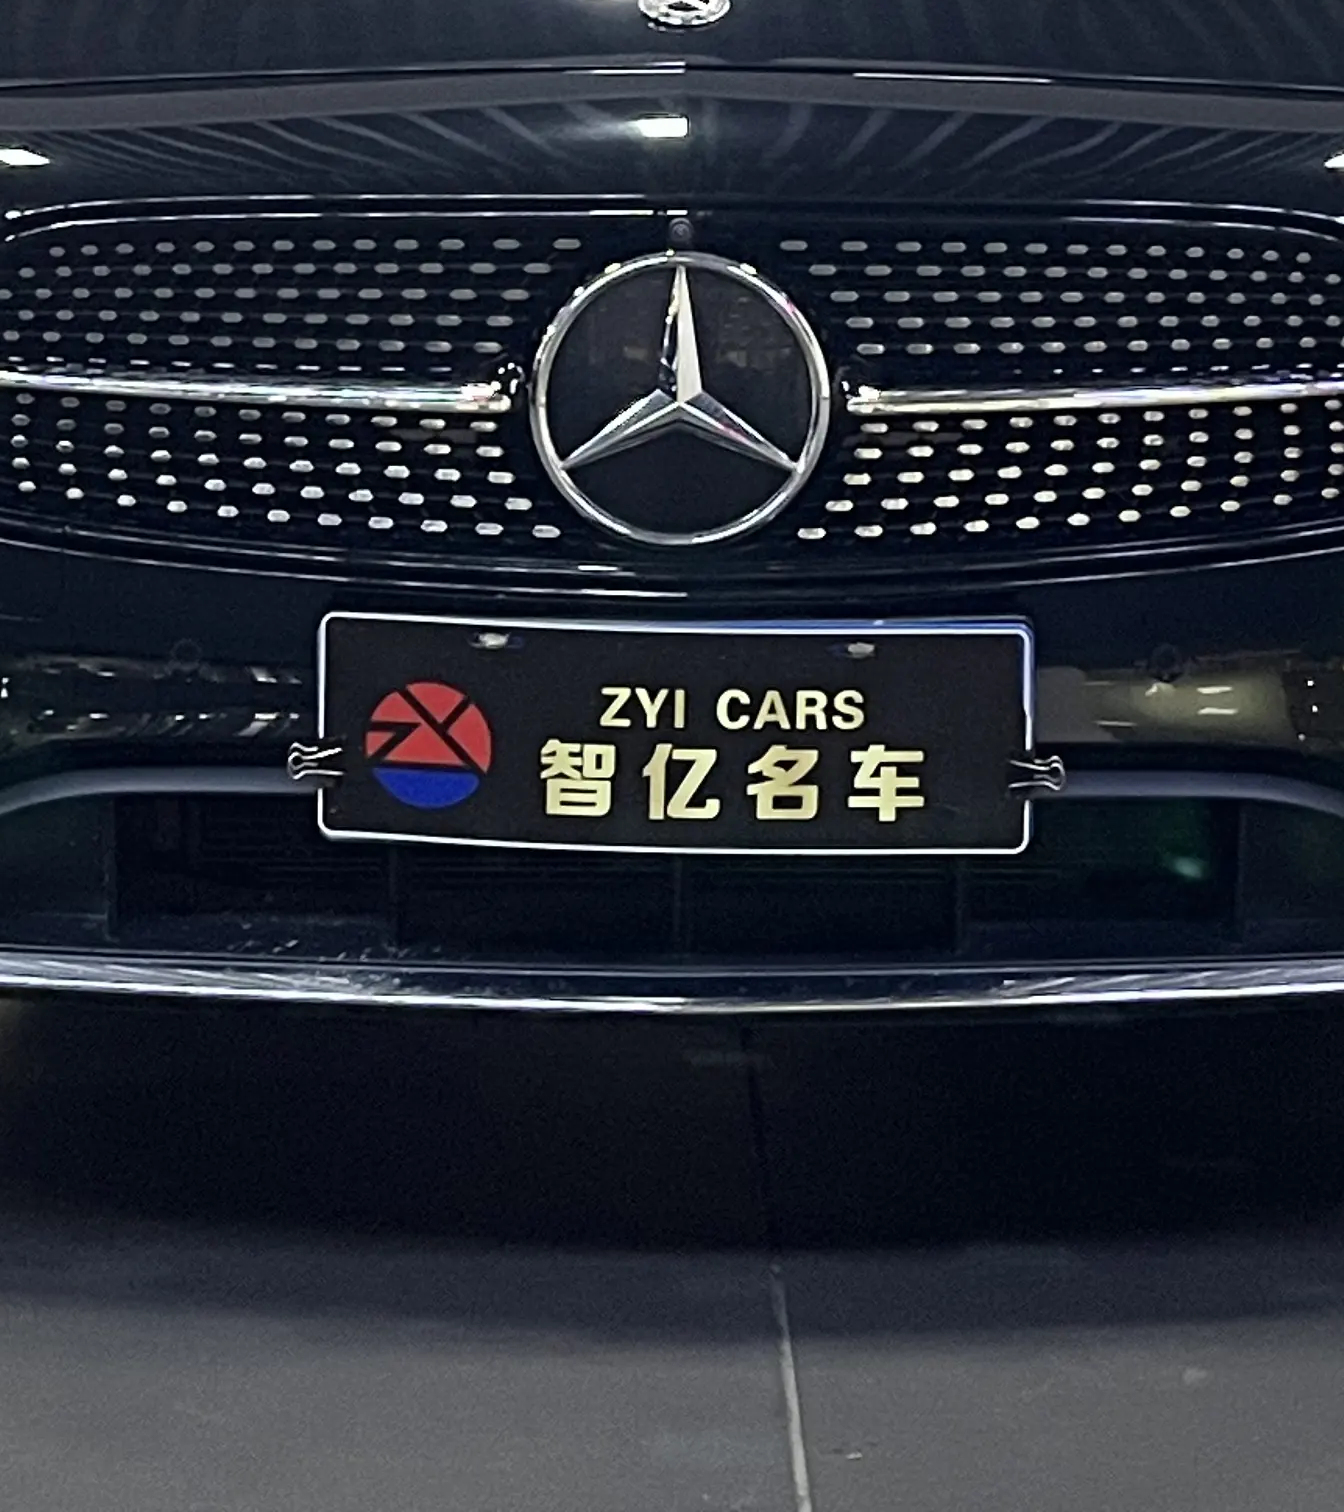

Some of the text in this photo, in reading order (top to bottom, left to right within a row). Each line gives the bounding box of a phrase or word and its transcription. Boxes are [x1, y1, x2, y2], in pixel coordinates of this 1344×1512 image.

[600, 686, 866, 732] ZYI CARS
[540, 738, 924, 823] 智亿名车
